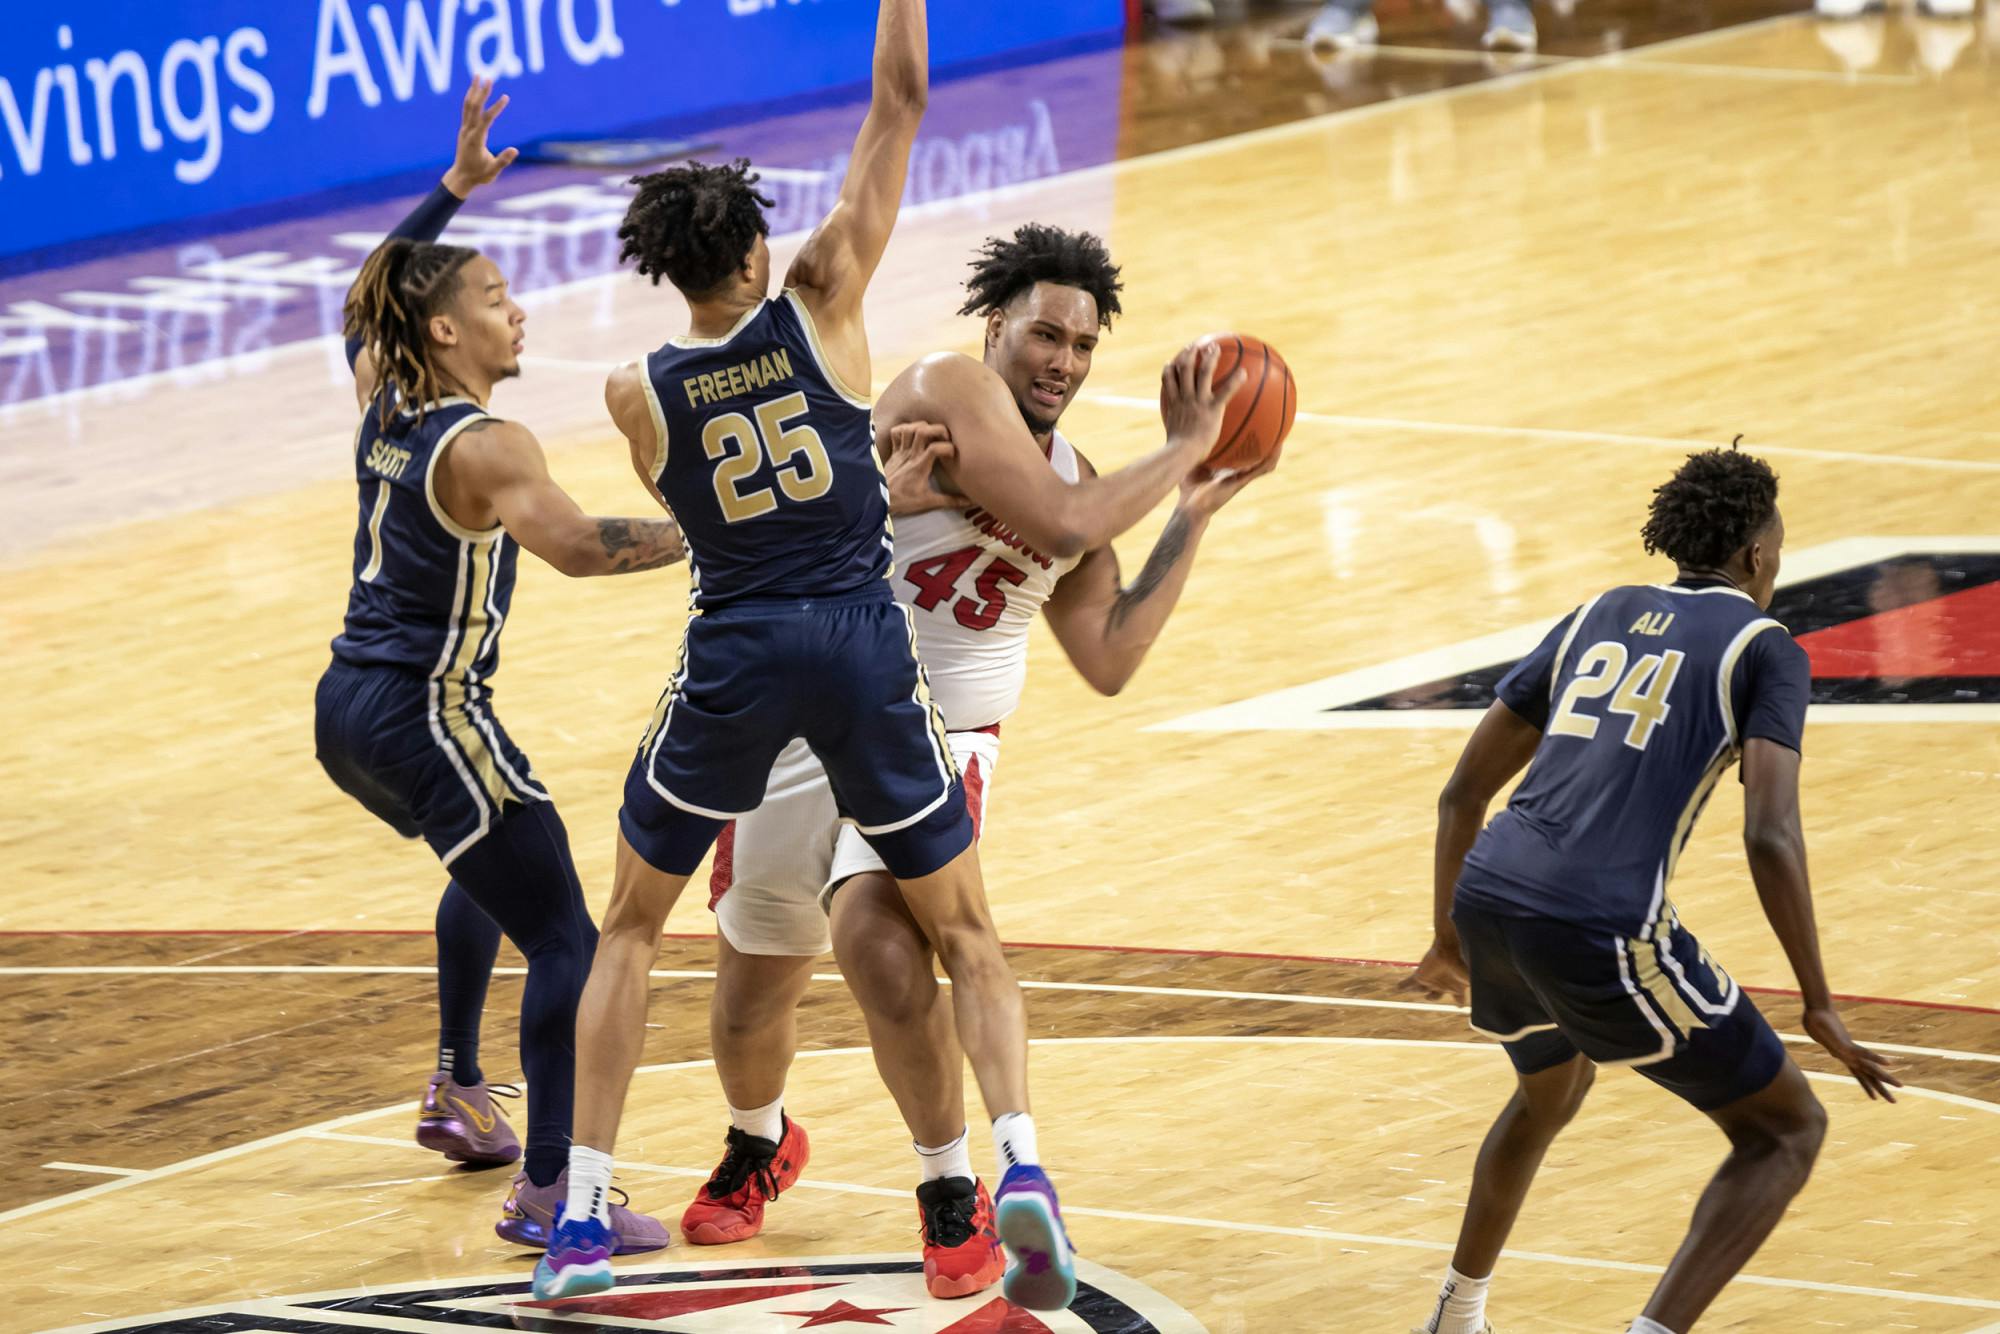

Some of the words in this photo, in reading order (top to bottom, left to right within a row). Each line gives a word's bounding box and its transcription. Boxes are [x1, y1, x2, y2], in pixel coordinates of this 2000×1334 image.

[0, 25, 275, 184] vings
[683, 347, 794, 409] FREEMAN
[366, 438, 412, 479] SCOTT
[702, 390, 833, 524] 25
[359, 480, 391, 583] 1
[903, 545, 1029, 632] 45
[1628, 611, 1675, 636] ALI
[1547, 640, 1686, 751] 24
